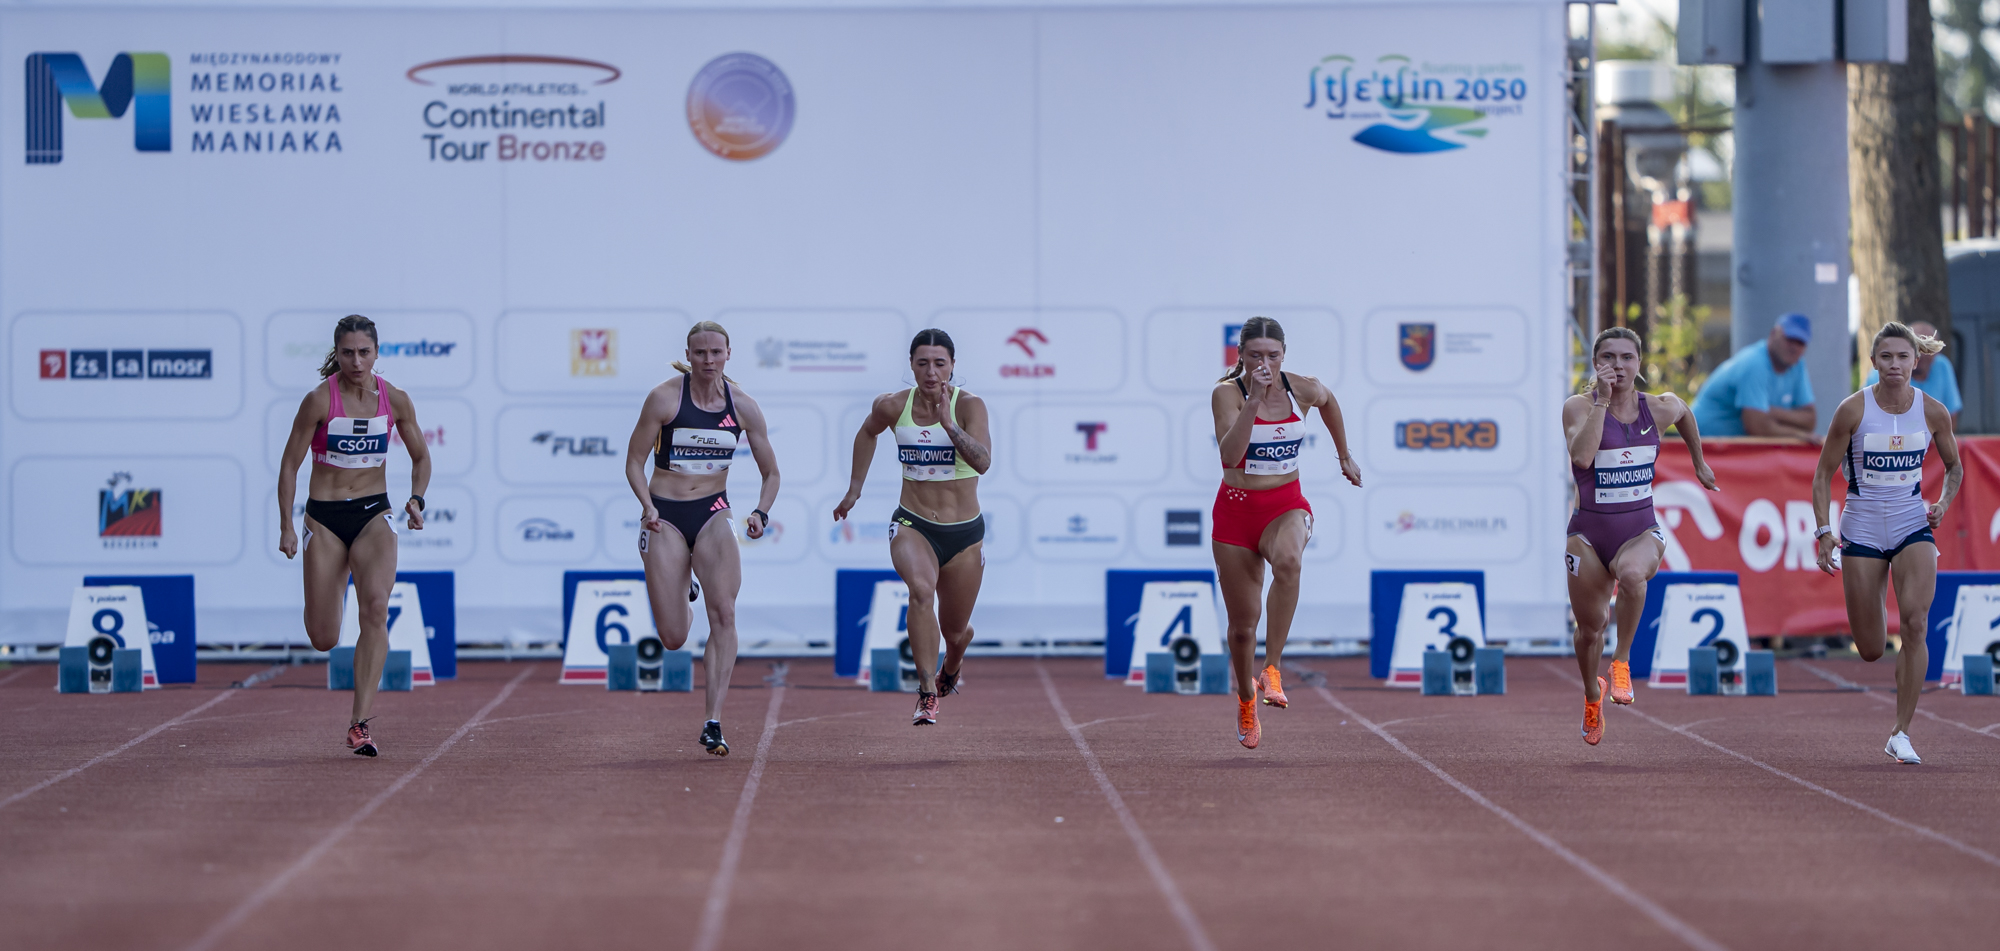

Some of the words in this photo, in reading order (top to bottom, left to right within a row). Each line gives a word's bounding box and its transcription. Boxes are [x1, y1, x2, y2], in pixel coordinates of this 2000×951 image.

[190, 53, 342, 66] MIĘDZYNARODOWY
[190, 73, 344, 92] MEMORIAŁ
[447, 84, 498, 95] WORLD
[502, 84, 579, 95] ATHLETICS
[1455, 78, 1527, 101] 2050
[190, 104, 342, 123] WIESŁAWA
[423, 101, 605, 129] Continental
[191, 132, 343, 152] MANIAKA
[422, 135, 490, 161] Tour
[498, 135, 606, 161] Bronze
[115, 358, 140, 376] sa
[151, 358, 207, 376] mosr
[999, 365, 1056, 378] ORLEN
[337, 437, 379, 452] CSÓTI
[697, 437, 720, 445] FUEL
[1404, 421, 1498, 449] eska
[552, 437, 618, 457] FUEL
[673, 446, 732, 456] WESSOLLY
[1255, 444, 1298, 459] GROSS
[1866, 454, 1922, 468] KOTWIŁA
[1598, 467, 1653, 485] TSIMANOUSKAYA
[640, 530, 648, 551] 6
[1566, 554, 1575, 573] 3
[92, 608, 126, 649] 8
[595, 603, 631, 657] 6
[1160, 604, 1192, 648] 4
[1426, 606, 1458, 651] 3
[1690, 608, 1725, 649] 2
